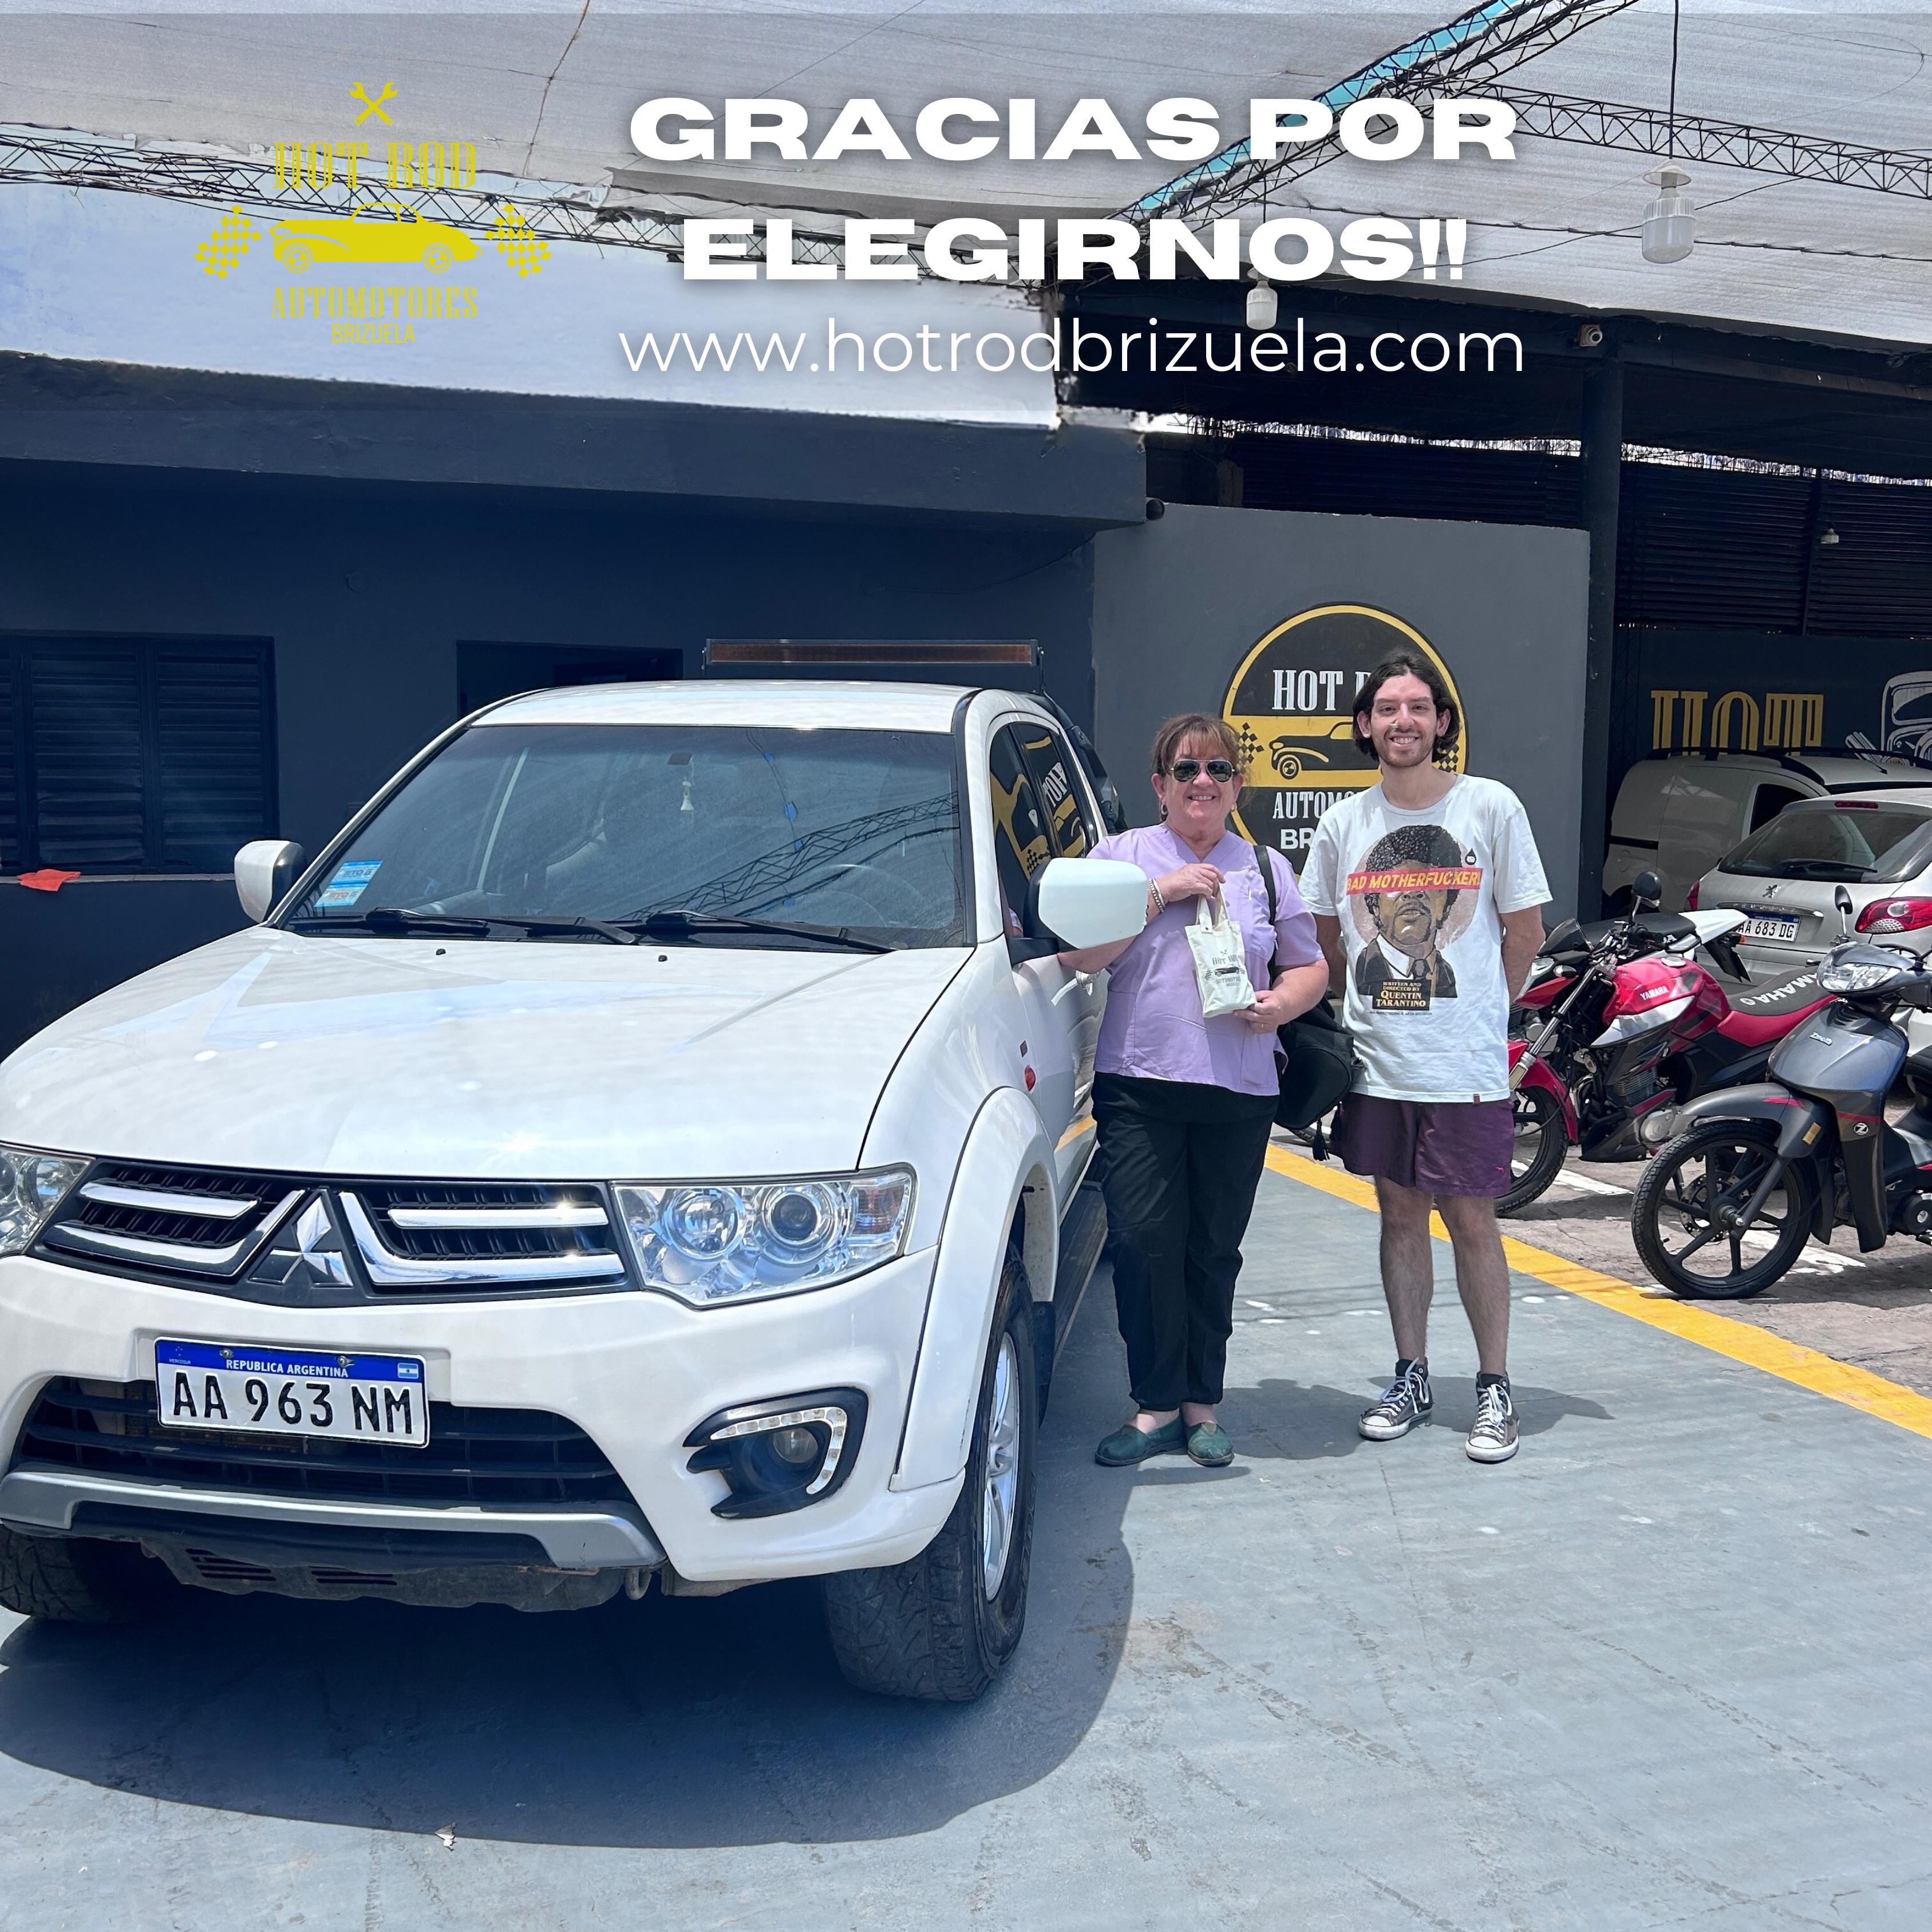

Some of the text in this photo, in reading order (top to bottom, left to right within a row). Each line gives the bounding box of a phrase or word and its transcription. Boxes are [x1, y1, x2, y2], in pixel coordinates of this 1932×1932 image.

[1271, 670, 1343, 710] HOT
[1755, 920, 1777, 937] 683
[1779, 923, 1795, 938] DG
[1381, 990, 1421, 999] QUENTIN
[1640, 985, 1669, 1001] YAMAHA
[1376, 999, 1426, 1007] TARANTINO
[226, 1359, 349, 1378] REPUBLICA ARGENTINA
[173, 1372, 413, 1435] AA 963 NM
